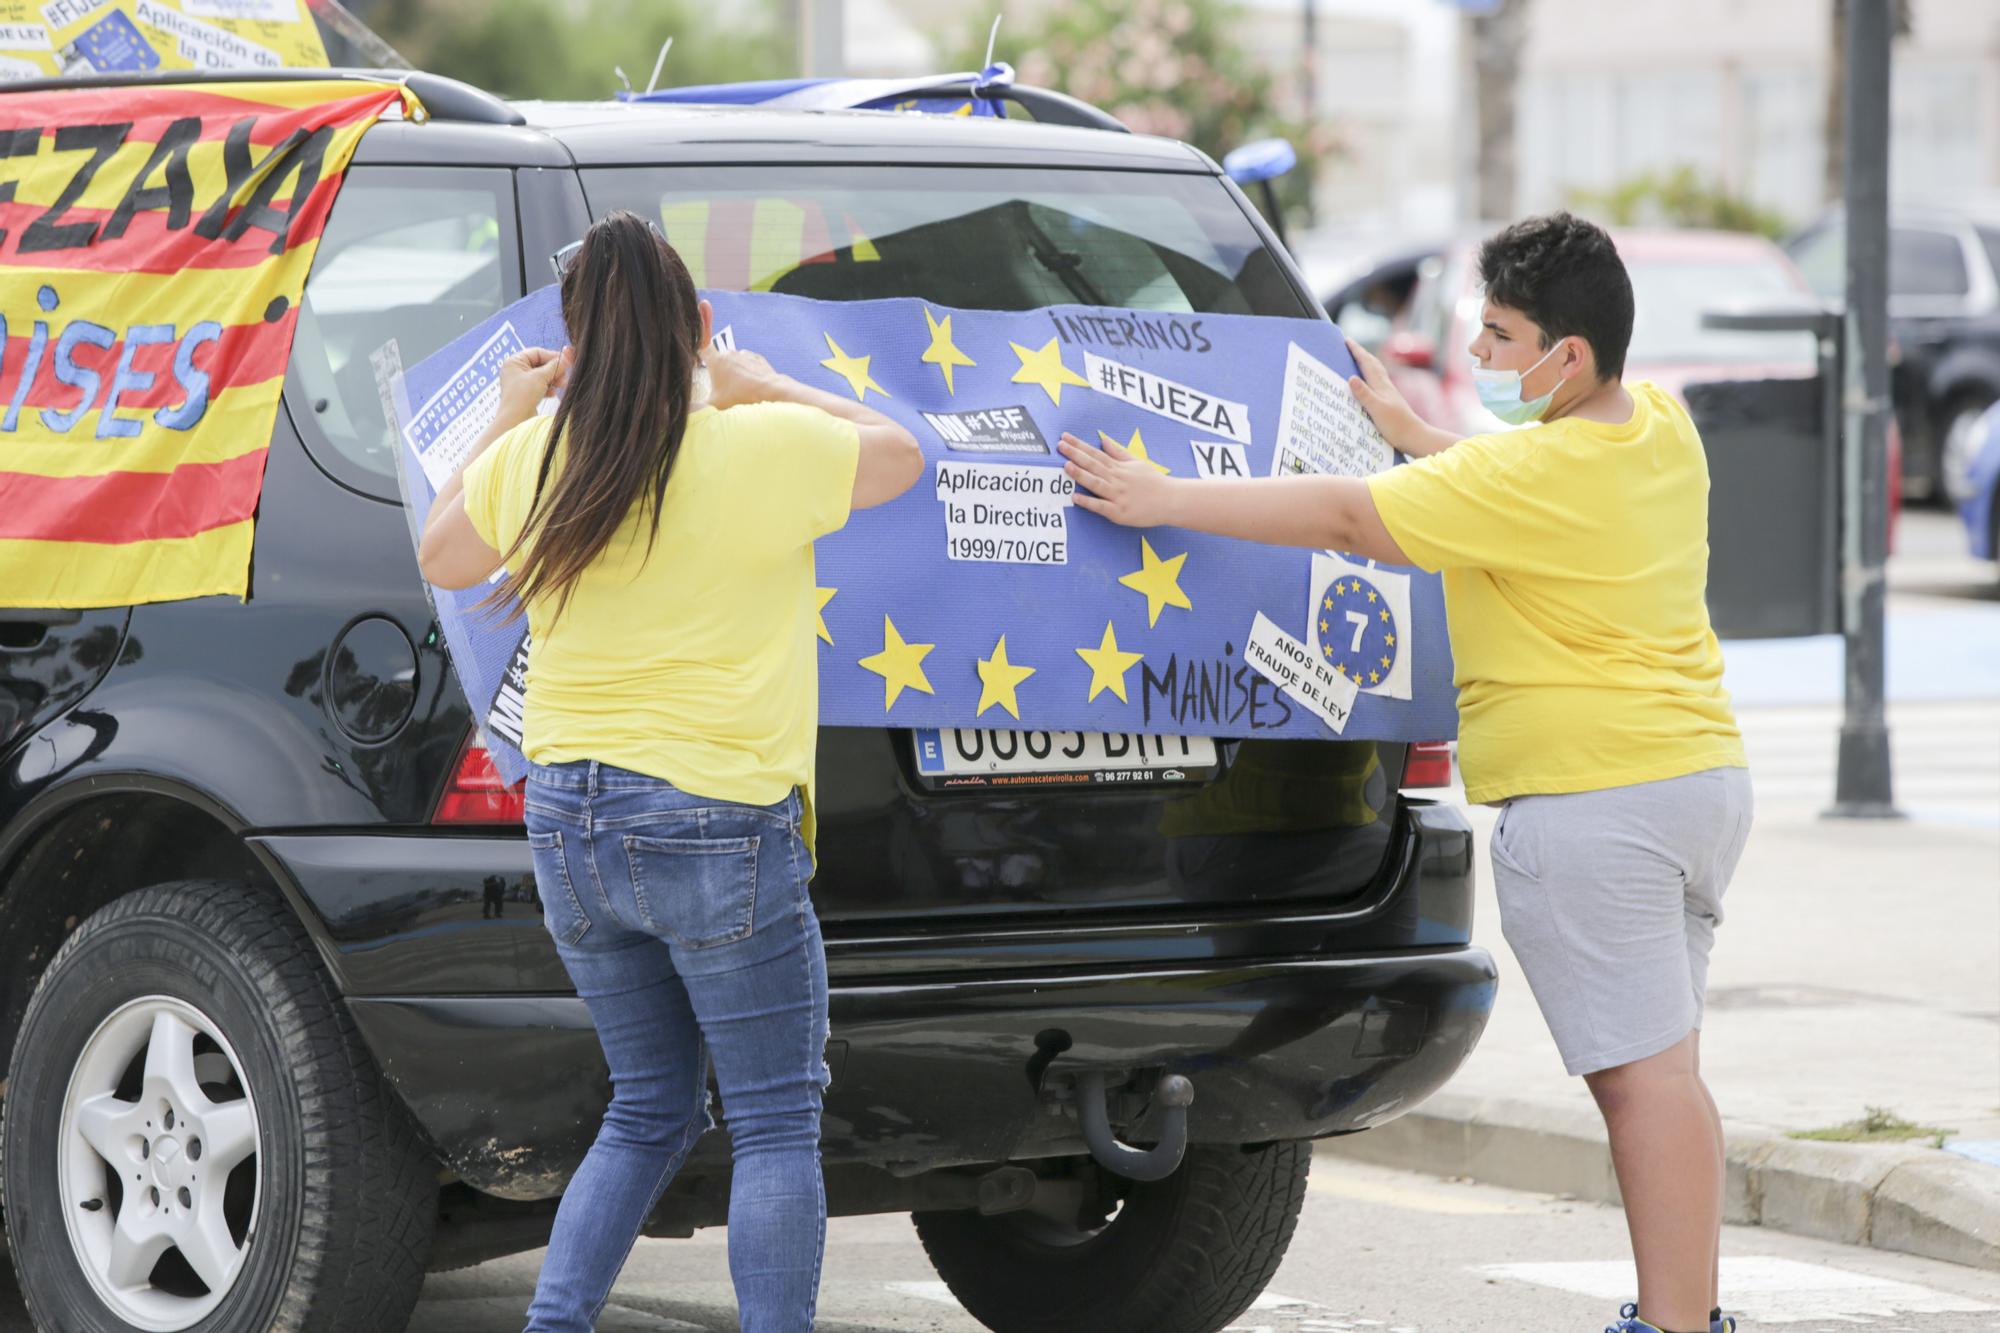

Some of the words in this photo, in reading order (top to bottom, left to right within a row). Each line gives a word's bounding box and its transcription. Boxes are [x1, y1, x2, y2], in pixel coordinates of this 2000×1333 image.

[137, 3, 247, 60] Aplicación
[413, 369, 478, 435] SENTENCIA
[479, 334, 510, 368] TJUE
[1099, 363, 1236, 435] #FIJEZA
[1296, 376, 1311, 393] SIN
[1313, 388, 1356, 423] RESARCIR
[1297, 361, 1345, 400] REFORMAR
[418, 433, 432, 449] 11
[434, 376, 487, 431] FEBRERO
[965, 408, 1023, 431] #15F
[1292, 405, 1304, 421] ES
[1307, 416, 1356, 457] CONTRARIO
[1290, 420, 1335, 457] DIRECTIVA
[1337, 419, 1353, 438] DEL
[1356, 437, 1384, 463] ABUSO
[937, 468, 1043, 494] Aplicación
[1050, 474, 1073, 495] de
[1195, 444, 1242, 477] YA
[949, 503, 966, 523] la
[973, 504, 1062, 528] Directiva
[950, 538, 1064, 562] 1999/70/CE
[1345, 610, 1368, 652] 7
[1248, 639, 1298, 687] FRAUDE
[1301, 680, 1320, 702] DE
[1322, 699, 1347, 722] LEY
[1274, 637, 1313, 668] AÑOS
[1315, 665, 1333, 687] EN
[924, 741, 936, 759] E
[1105, 772, 1115, 781] 96
[1116, 772, 1131, 781] 277
[1133, 771, 1143, 780] 92
[1144, 771, 1153, 780] 61
